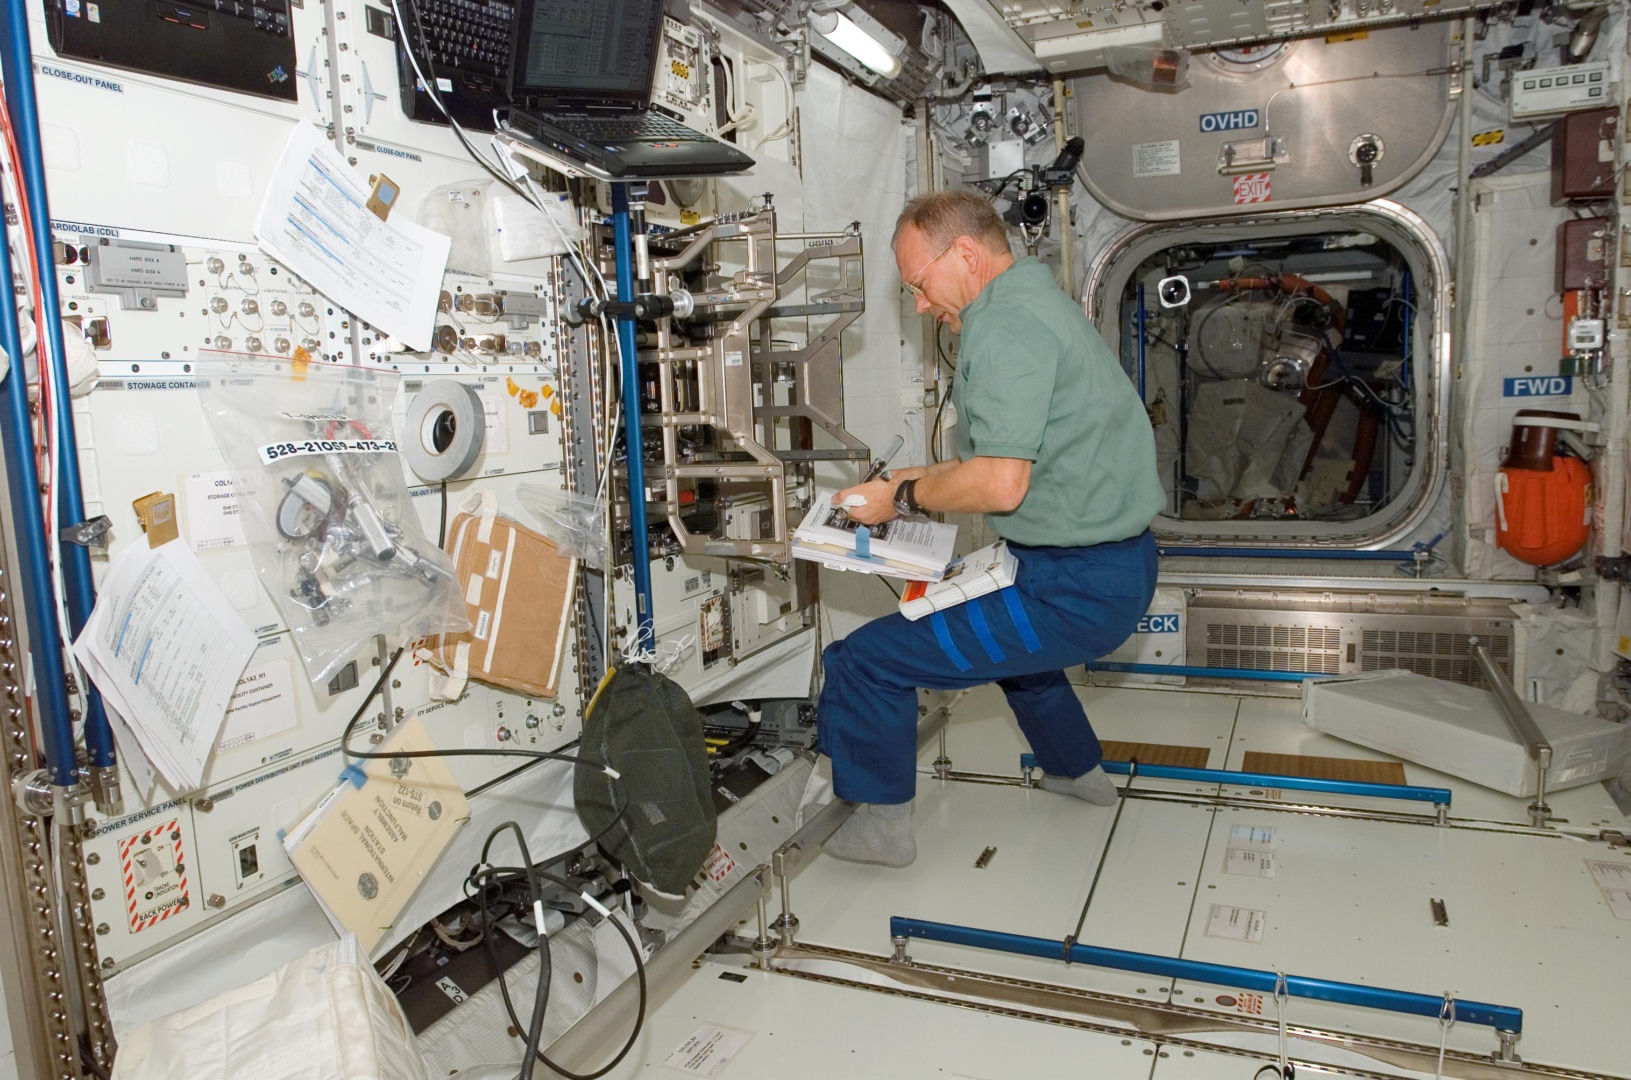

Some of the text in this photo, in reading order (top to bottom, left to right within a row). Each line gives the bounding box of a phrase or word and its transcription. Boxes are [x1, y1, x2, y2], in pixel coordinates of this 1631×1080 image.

[42, 66, 123, 93] CLOSE-OUT PANEL
[1201, 111, 1258, 132] OVHD
[376, 146, 422, 162] CLOSE-OUT PANEL
[1239, 181, 1265, 199] EXIT
[50, 222, 119, 238] ARDIOLAB (CDL)
[127, 382, 167, 390] STOWAGE
[1513, 378, 1566, 396] FWD
[1136, 616, 1176, 632] ECK
[231, 690, 249, 699] ACILITY
[426, 704, 444, 713] SERVICE
[235, 779, 255, 791] POWER
[255, 767, 288, 784] DISTRIBUTION
[314, 749, 332, 762] ACCESS
[398, 785, 423, 801] STS-122
[392, 795, 422, 814] Return on
[96, 797, 187, 836] POWER SERVICE PANEL
[374, 794, 407, 841] MALFUNCTION
[363, 825, 386, 854] STATION
[359, 832, 395, 884] INTERNATIONAL
[139, 909, 157, 922] RACK
